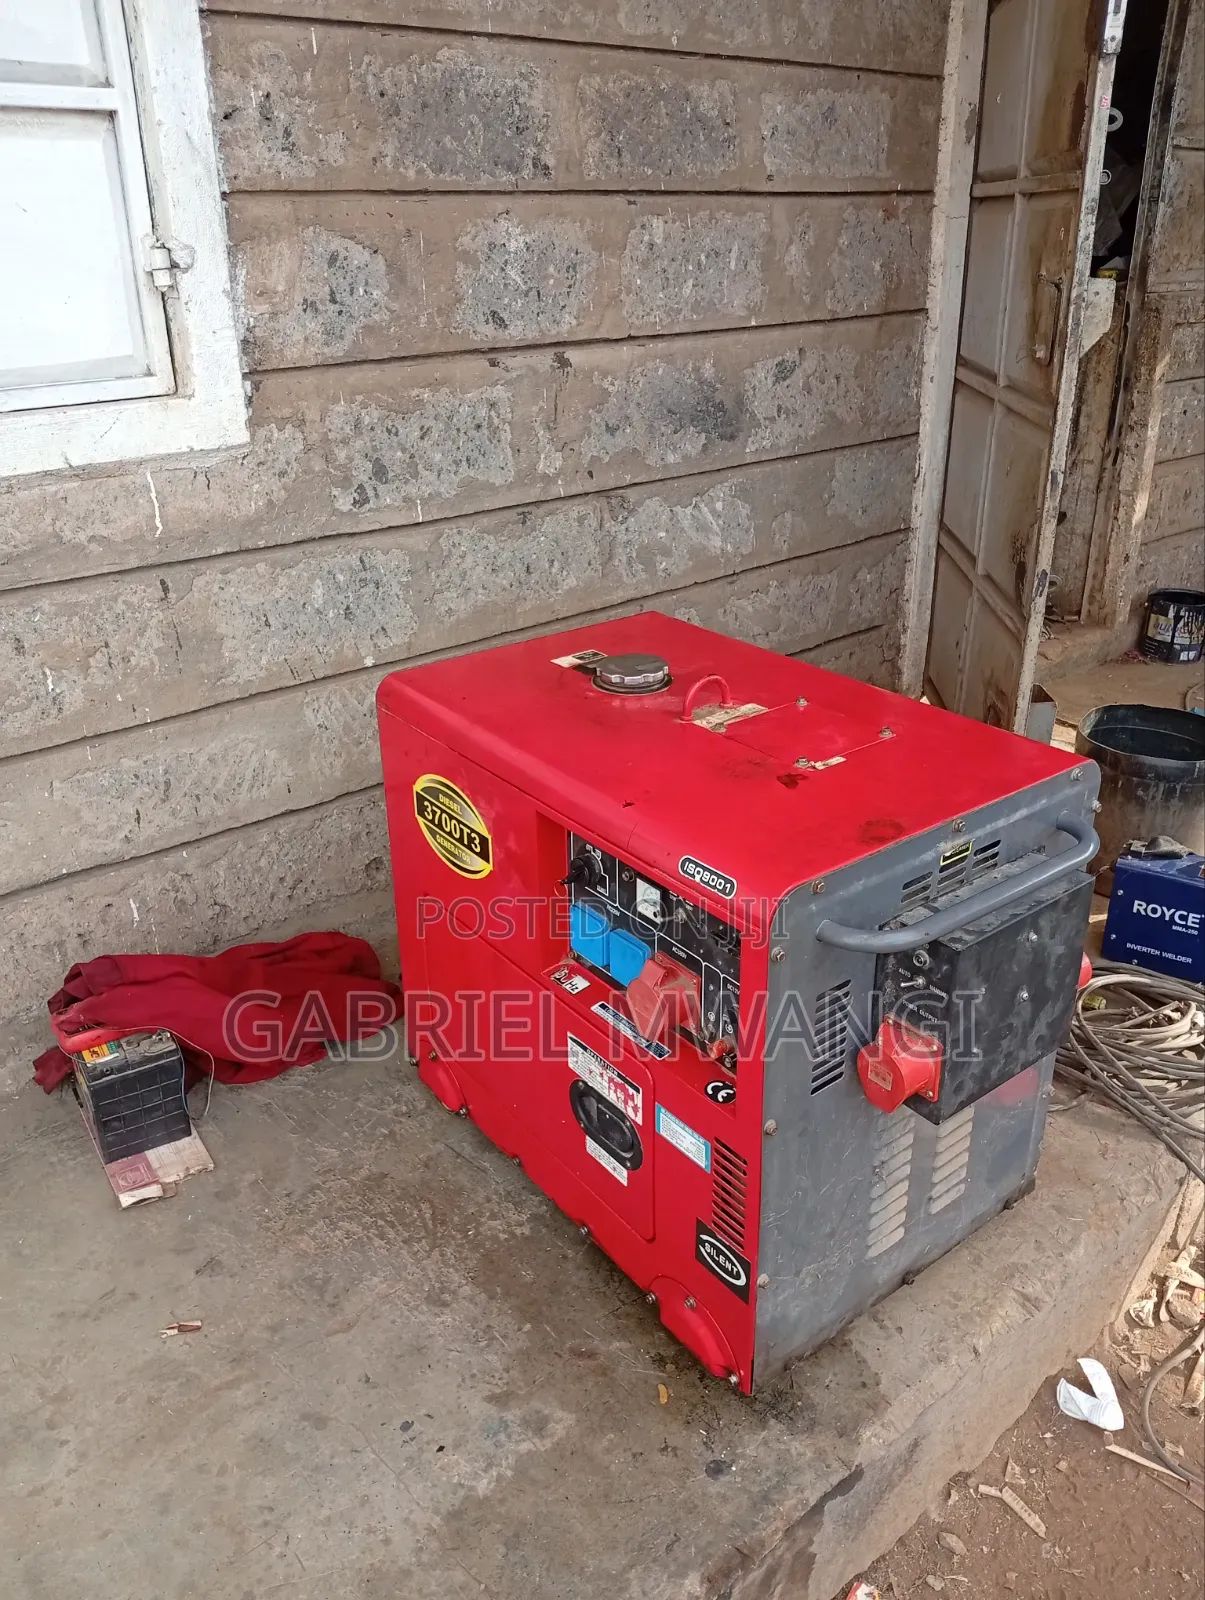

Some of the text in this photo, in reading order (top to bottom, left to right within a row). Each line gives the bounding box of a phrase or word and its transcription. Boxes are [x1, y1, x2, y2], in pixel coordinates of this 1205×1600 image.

[438, 792, 463, 816] DIESEL
[423, 800, 481, 853] 3700T3
[435, 834, 471, 865] GENERATOR
[683, 861, 731, 894] ISO9001
[1132, 899, 1200, 928] ROYCE
[1126, 942, 1192, 964] INVERTER WELDER
[899, 967, 911, 978] AUTO
[586, 1048, 619, 1077] OPERATION
[706, 1081, 735, 1103] CE
[704, 1242, 738, 1276] SILENT
